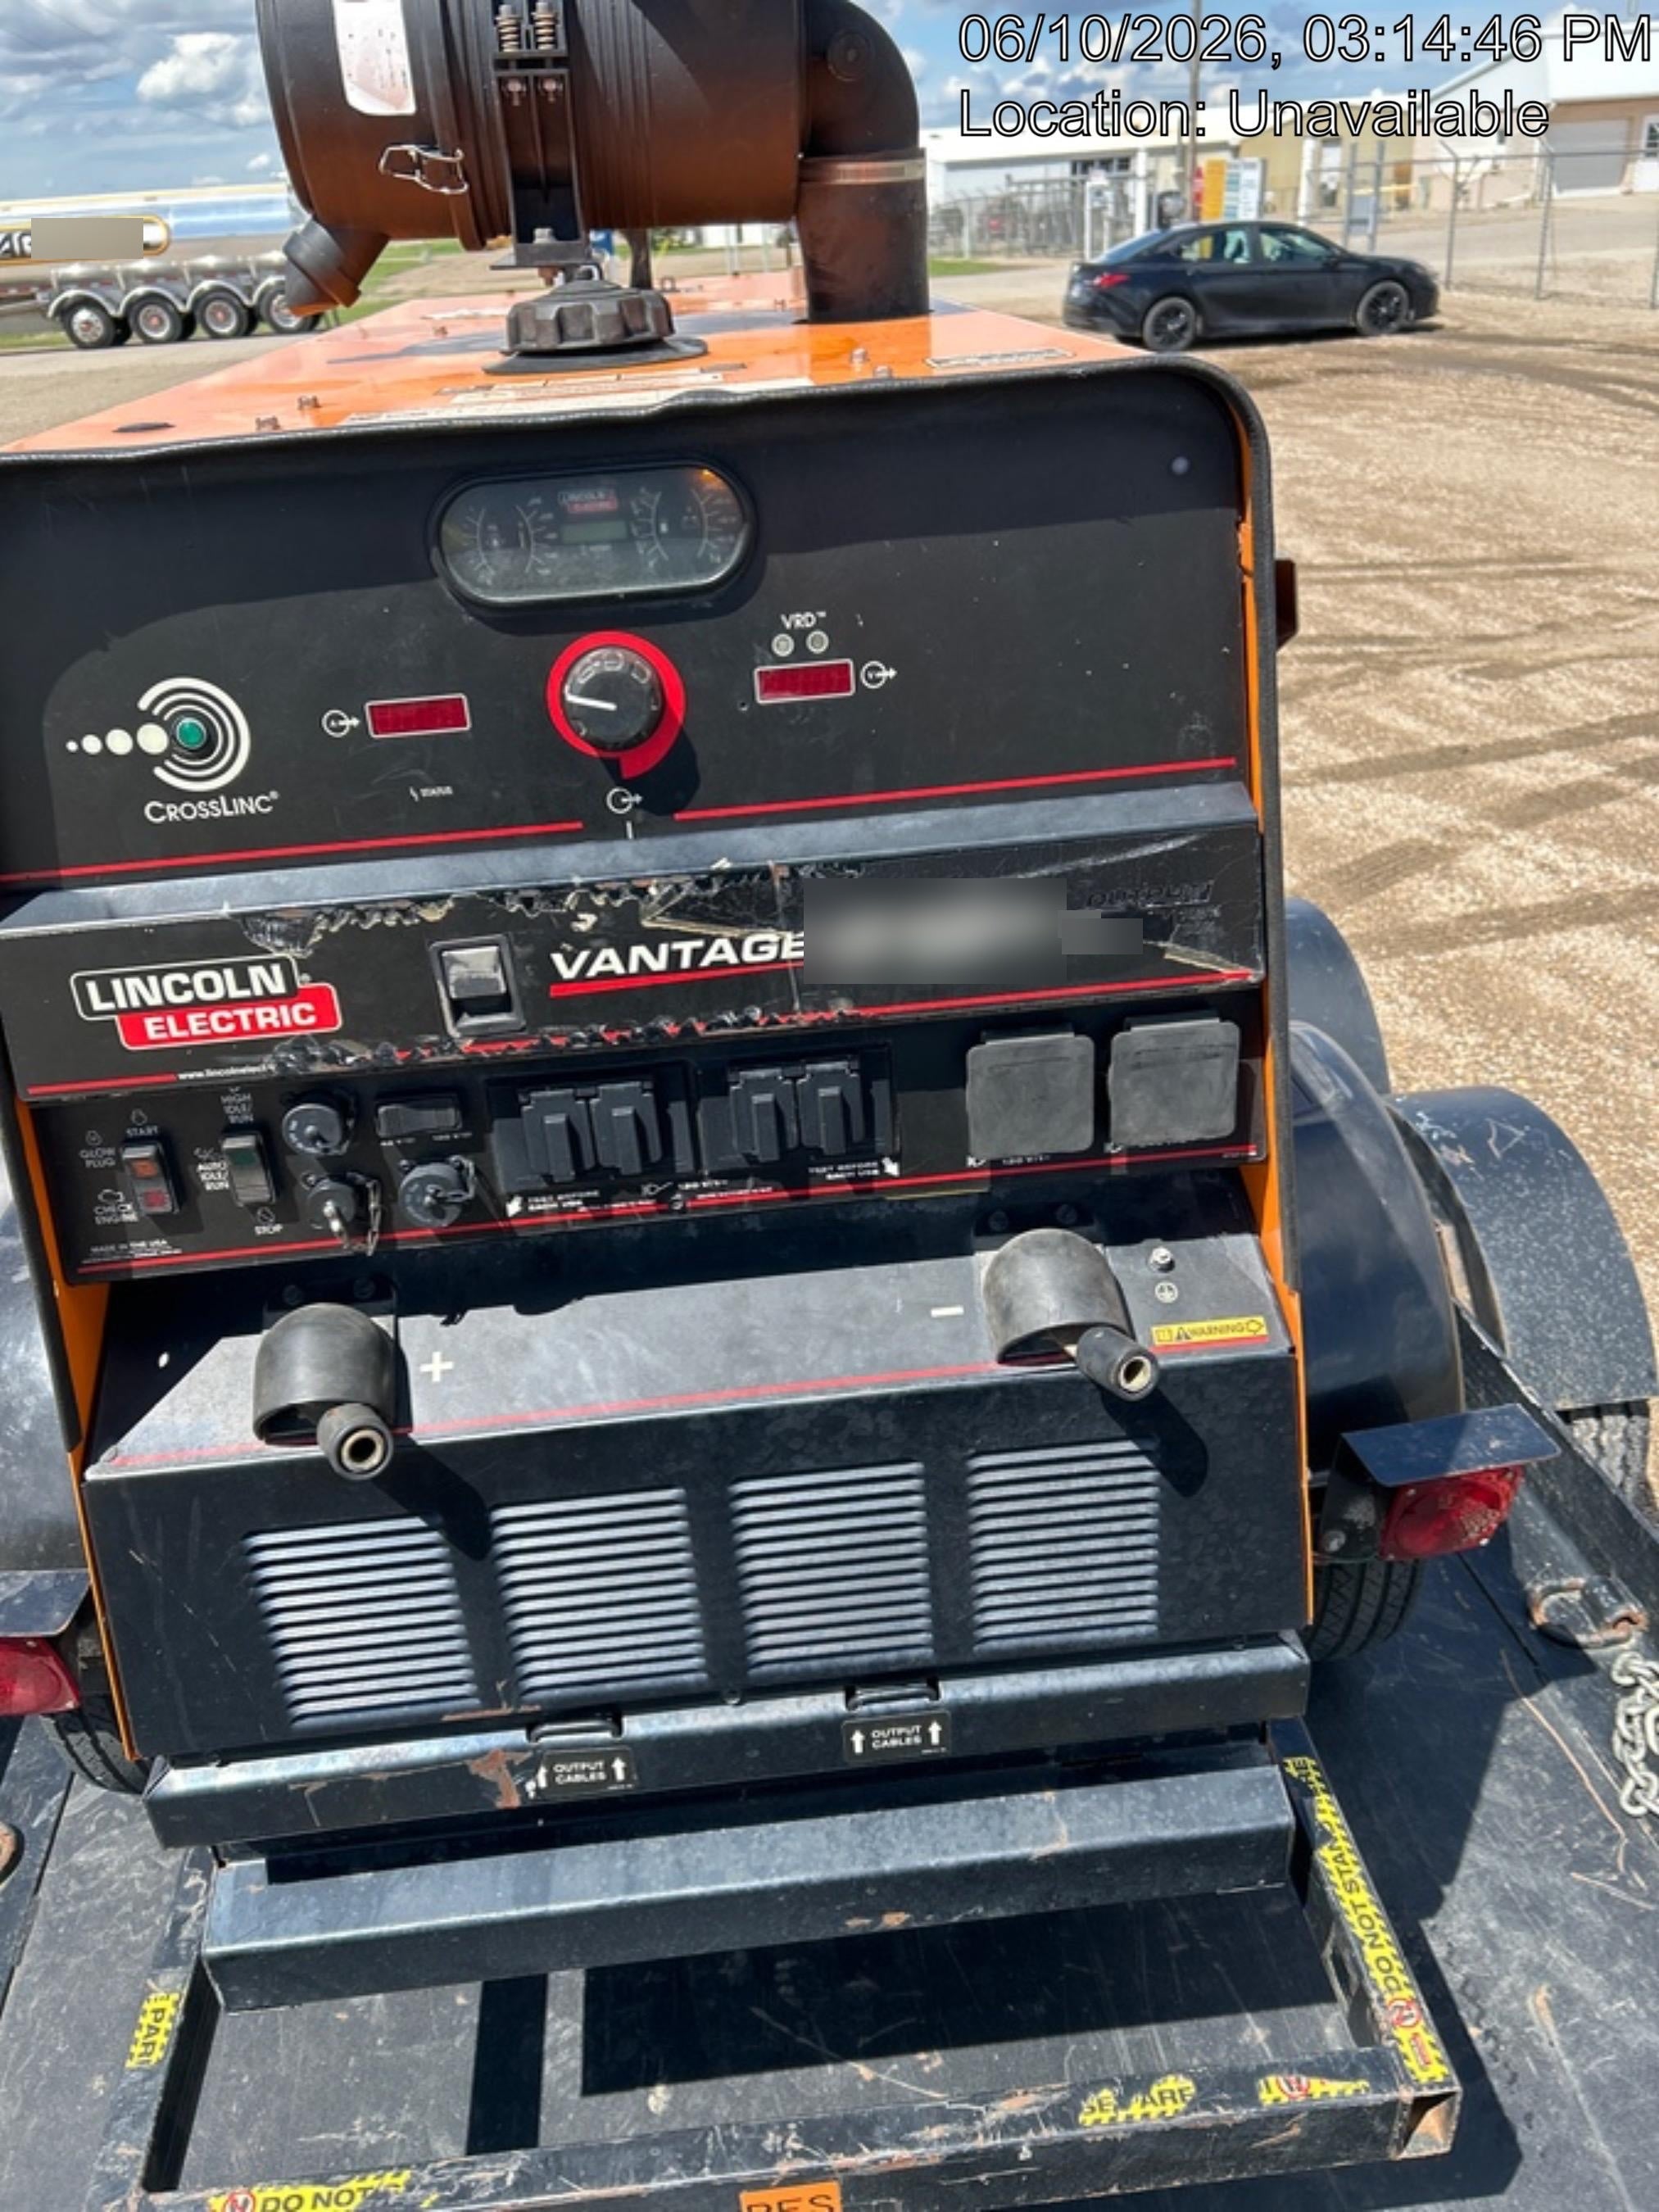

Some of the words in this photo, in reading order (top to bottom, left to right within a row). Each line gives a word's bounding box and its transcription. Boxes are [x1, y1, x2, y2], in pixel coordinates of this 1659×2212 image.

[85, 963, 288, 1012] LINCOLN
[143, 1002, 318, 1041] ELECTRIC
[126, 1125, 158, 1137] START
[85, 1157, 116, 1168] PLUG
[255, 1223, 283, 1235] STOP
[872, 1725, 922, 1738] OUTPUT
[872, 1735, 922, 1750] CABLES
[552, 1760, 605, 1773] OUTPUT
[555, 1771, 606, 1784] CABLES
[1352, 1900, 1384, 1950] NOT
[1376, 1956, 1403, 1994] DO
[261, 2195, 305, 2212] DO
[311, 2187, 374, 2210] NOT
